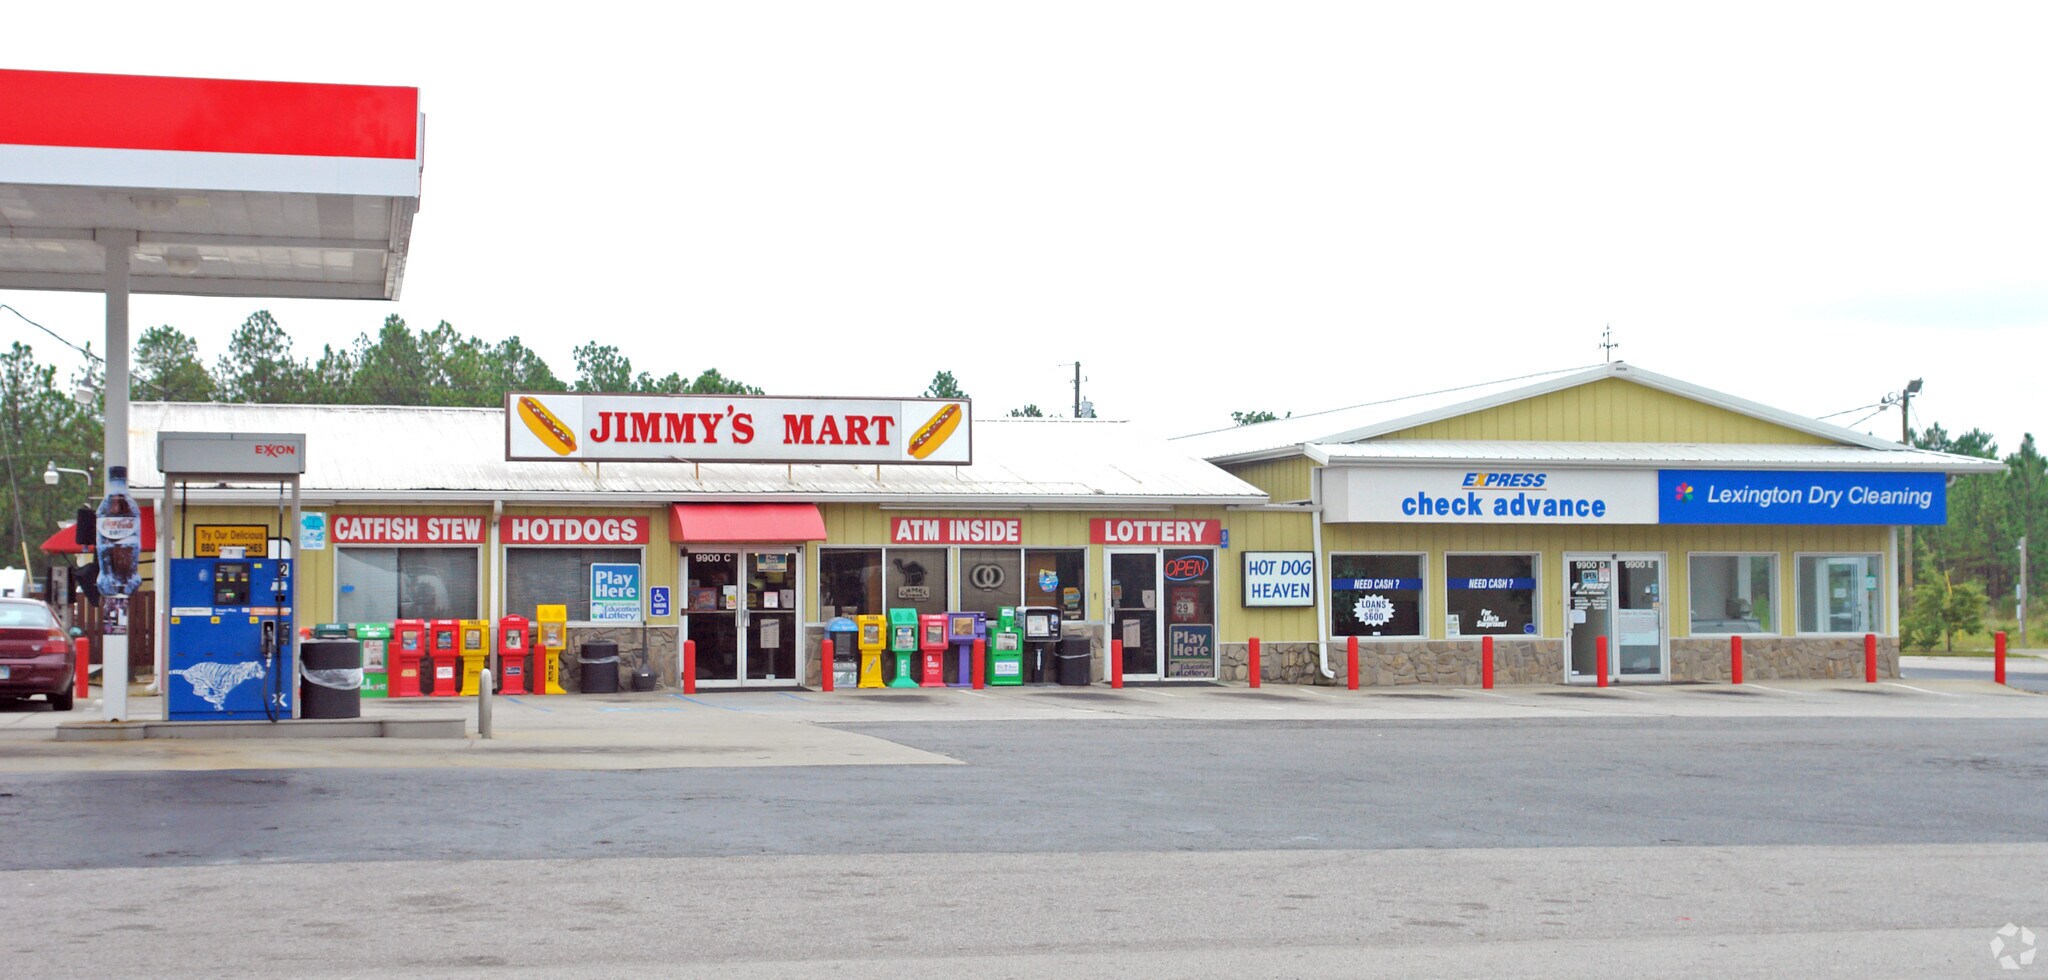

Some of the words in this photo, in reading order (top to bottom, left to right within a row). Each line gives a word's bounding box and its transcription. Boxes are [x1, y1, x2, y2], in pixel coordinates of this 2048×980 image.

[590, 404, 755, 444] JIMMY'S
[783, 414, 895, 446] MART
[255, 444, 295, 458] EXXON
[1462, 472, 1547, 487] EXPRESS
[1402, 491, 1483, 516] check
[1493, 492, 1606, 518] advance
[1708, 485, 1802, 508] Lexington
[1808, 486, 1842, 508] Dry
[1848, 486, 1932, 510] Cleaning
[201, 530, 211, 540] Try
[215, 530, 227, 539] Our
[230, 530, 263, 539] Delicious
[335, 517, 419, 540] CATFISH
[427, 517, 481, 541] STEW
[511, 518, 638, 542] HOTDOGS
[896, 519, 939, 541] ATM
[949, 519, 1019, 542] INSIDE
[1105, 521, 1206, 542] LOTTERY
[201, 543, 215, 552] BBQ
[696, 554, 720, 562] 9900
[1576, 561, 1596, 569] 9900
[281, 563, 287, 577] 2
[1165, 560, 1205, 577] OPEN
[1249, 560, 1276, 575] HOT
[1281, 560, 1312, 575] DOG
[595, 571, 633, 588] Play
[1354, 579, 1373, 589] NEED
[1374, 579, 1394, 590] CASH
[1468, 579, 1487, 589] NEED
[1488, 579, 1507, 589] CASH
[595, 584, 636, 598] Here
[1251, 583, 1310, 598] HEAVEN
[1177, 603, 1188, 613] 29
[1364, 613, 1383, 621] $600
[1173, 631, 1206, 647] Play
[1173, 643, 1209, 656] Here
